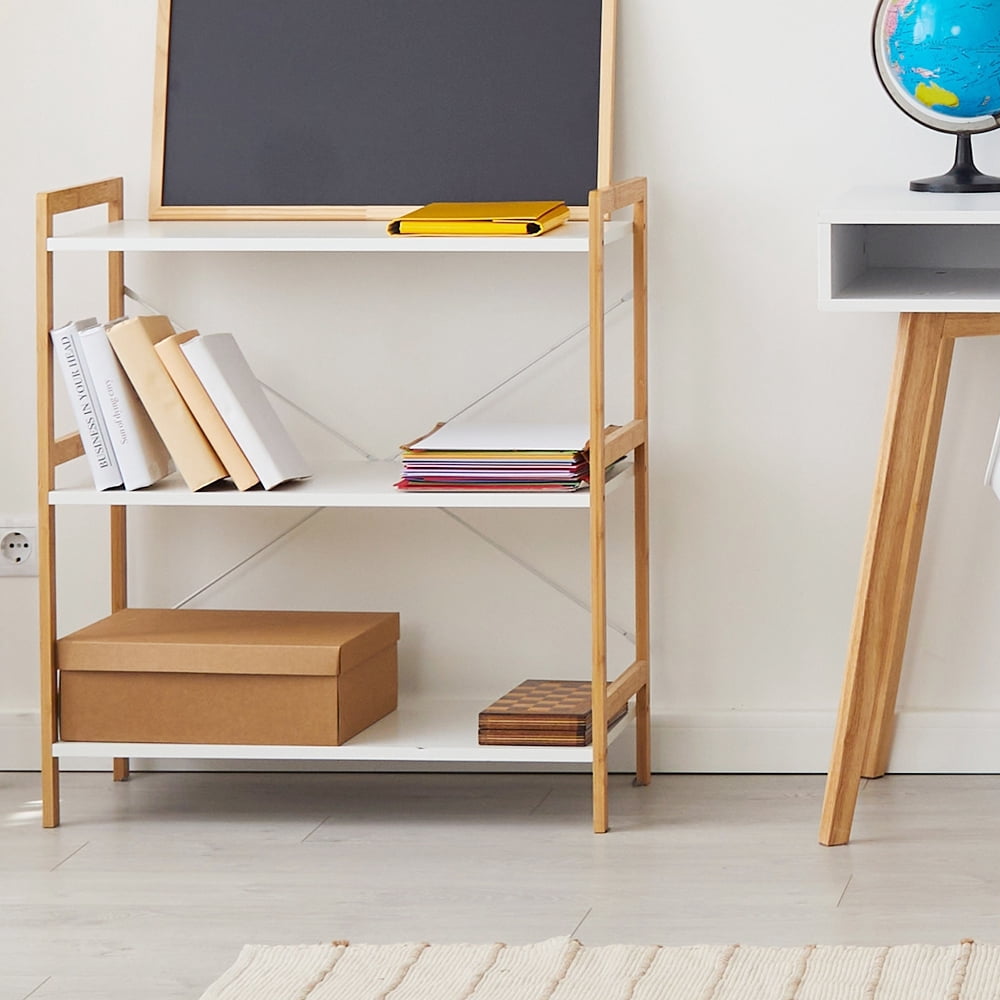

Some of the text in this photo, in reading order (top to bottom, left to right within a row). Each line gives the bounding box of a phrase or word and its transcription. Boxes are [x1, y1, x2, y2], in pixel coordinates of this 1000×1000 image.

[61, 336, 108, 468] BUSINESS IN YOUR HEAD
